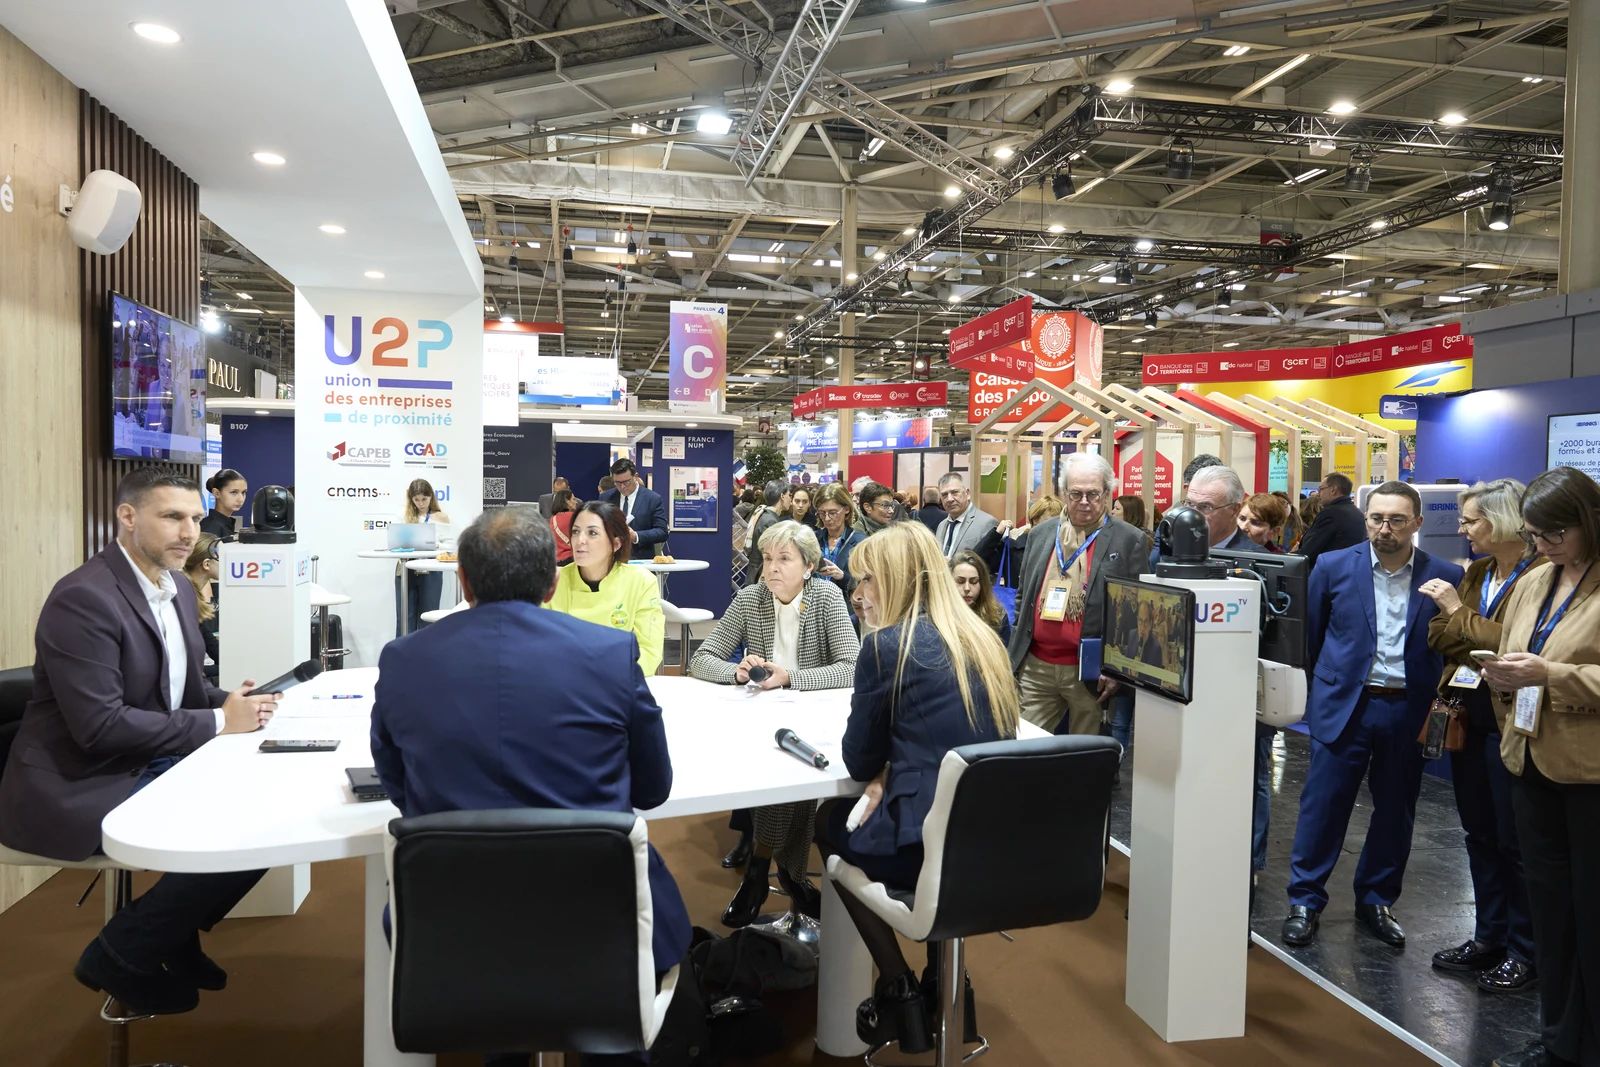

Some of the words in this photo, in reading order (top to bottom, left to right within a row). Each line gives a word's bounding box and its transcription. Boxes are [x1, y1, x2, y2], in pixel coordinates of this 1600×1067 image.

[717, 306, 725, 316] 4
[324, 314, 453, 368] U2P
[683, 344, 714, 380] C
[1345, 357, 1371, 366] TERRITOIRES
[208, 357, 242, 392] PAUL
[325, 373, 372, 388] union
[683, 388, 690, 396] B
[974, 389, 1003, 404] des
[324, 390, 354, 405] des
[359, 394, 452, 410] entreprises
[348, 410, 368, 423] de
[373, 411, 452, 427] proximité
[806, 430, 823, 440] Village
[404, 442, 448, 456] CGAD
[1560, 439, 1583, 447] +2000
[347, 447, 391, 459] CAPEB
[231, 562, 273, 578] U2P
[1195, 602, 1239, 623] U2P
